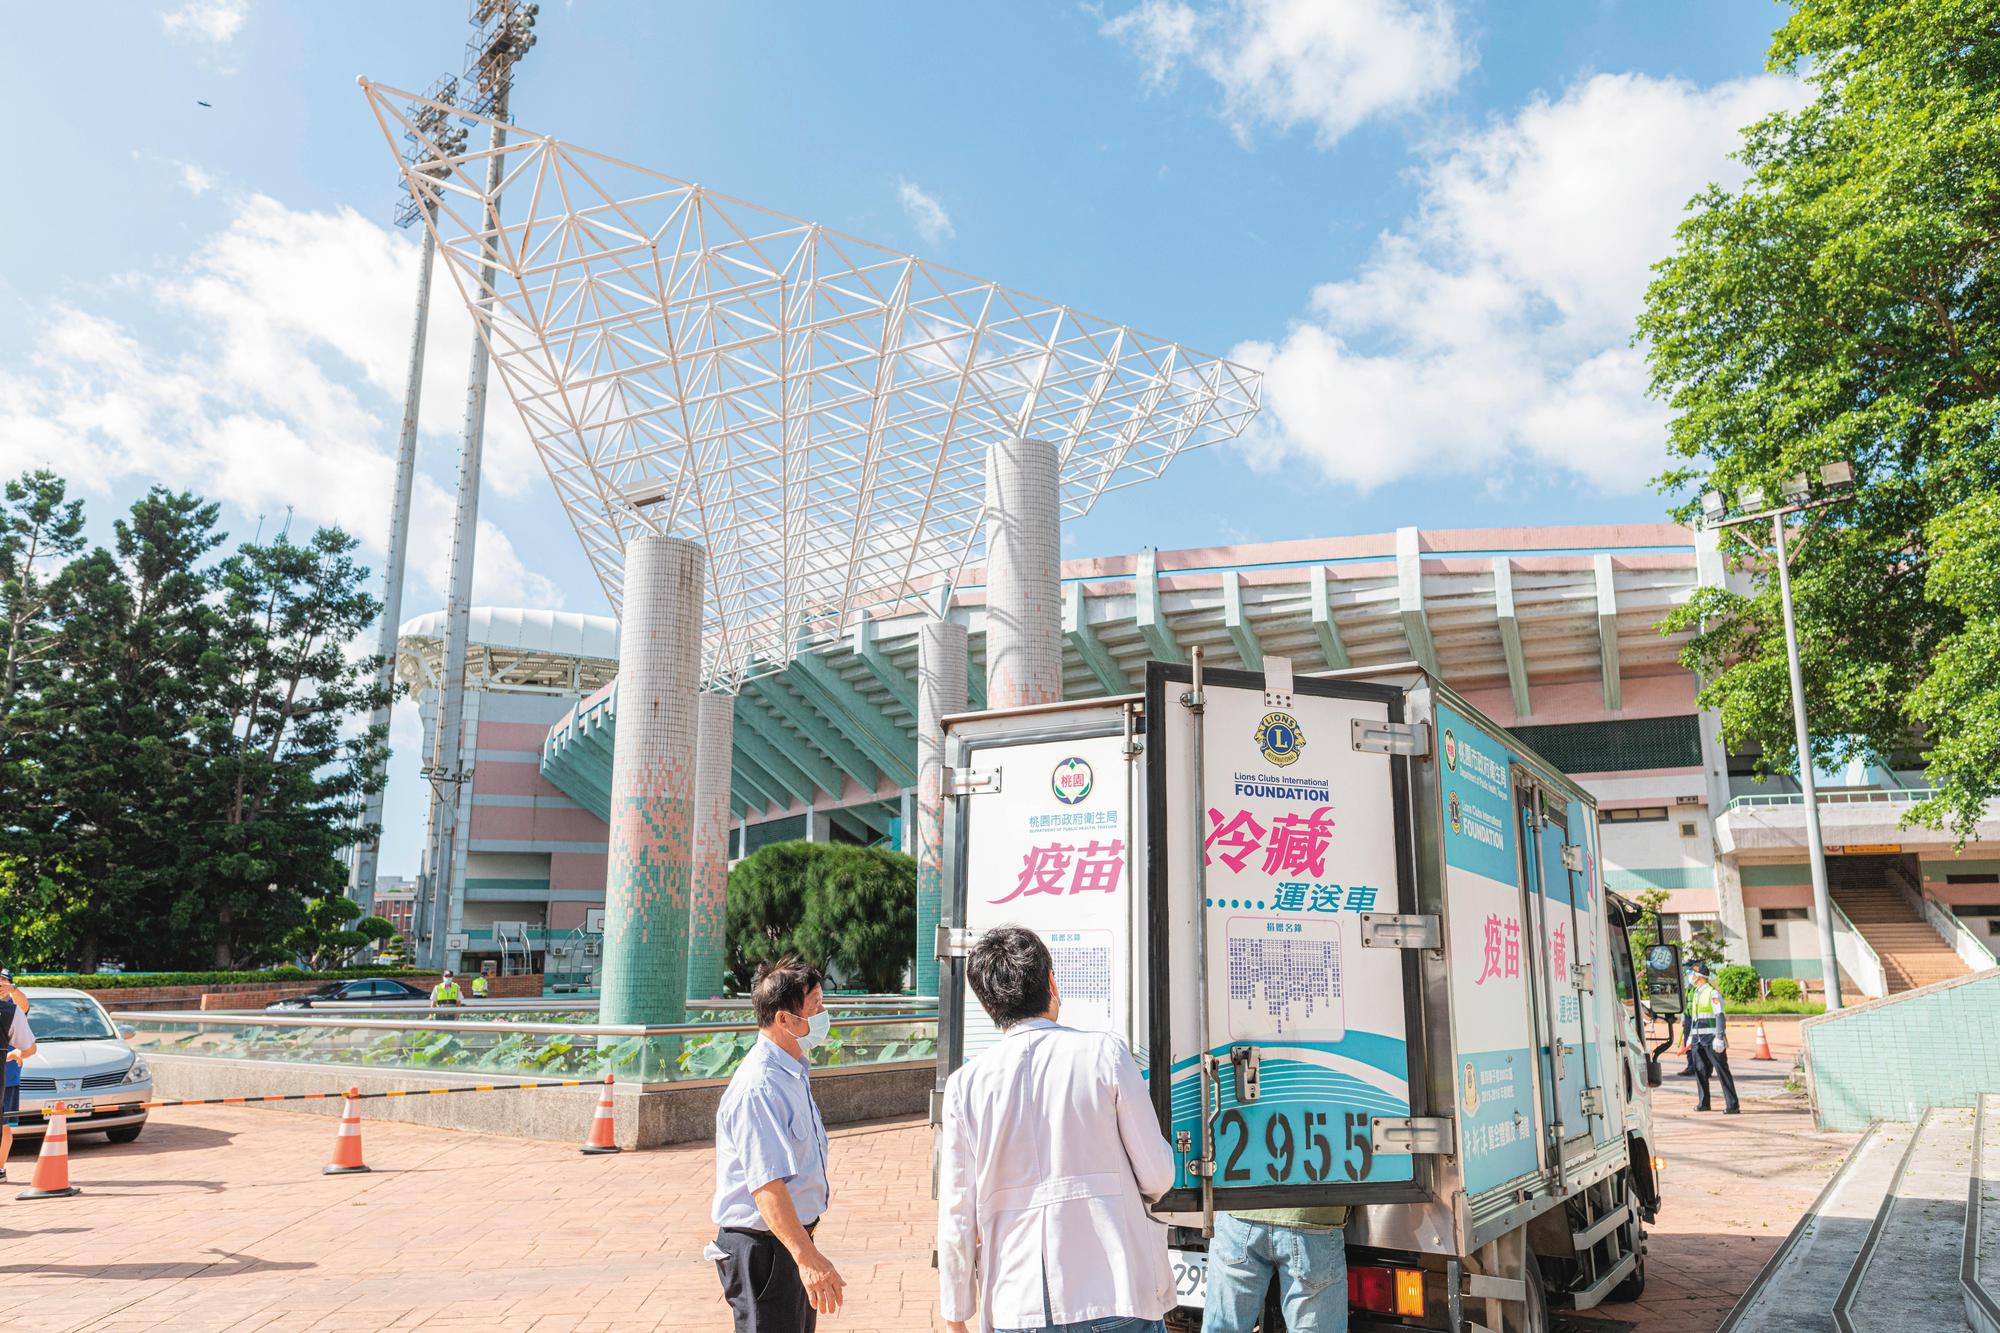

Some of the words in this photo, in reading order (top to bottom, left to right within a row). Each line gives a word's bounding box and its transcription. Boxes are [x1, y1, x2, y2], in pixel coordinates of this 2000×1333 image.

[1265, 714, 1295, 727] LIONS
[1275, 729, 1288, 748] L
[1061, 774, 1084, 787] 桃園
[1234, 772, 1256, 781] Lions
[1258, 774, 1280, 783] Clubs
[1282, 776, 1329, 787] International
[1235, 784, 1329, 802] FOUNDATION
[1029, 810, 1118, 828] 桃園市政府衛生局
[1205, 806, 1336, 878] 冷藏
[1463, 817, 1504, 851] FOUNDATION
[986, 839, 1125, 904] 疫苗
[1270, 882, 1378, 913] 運送車
[1475, 912, 1520, 985] 疫苗
[1220, 1109, 1373, 1182] 2955
